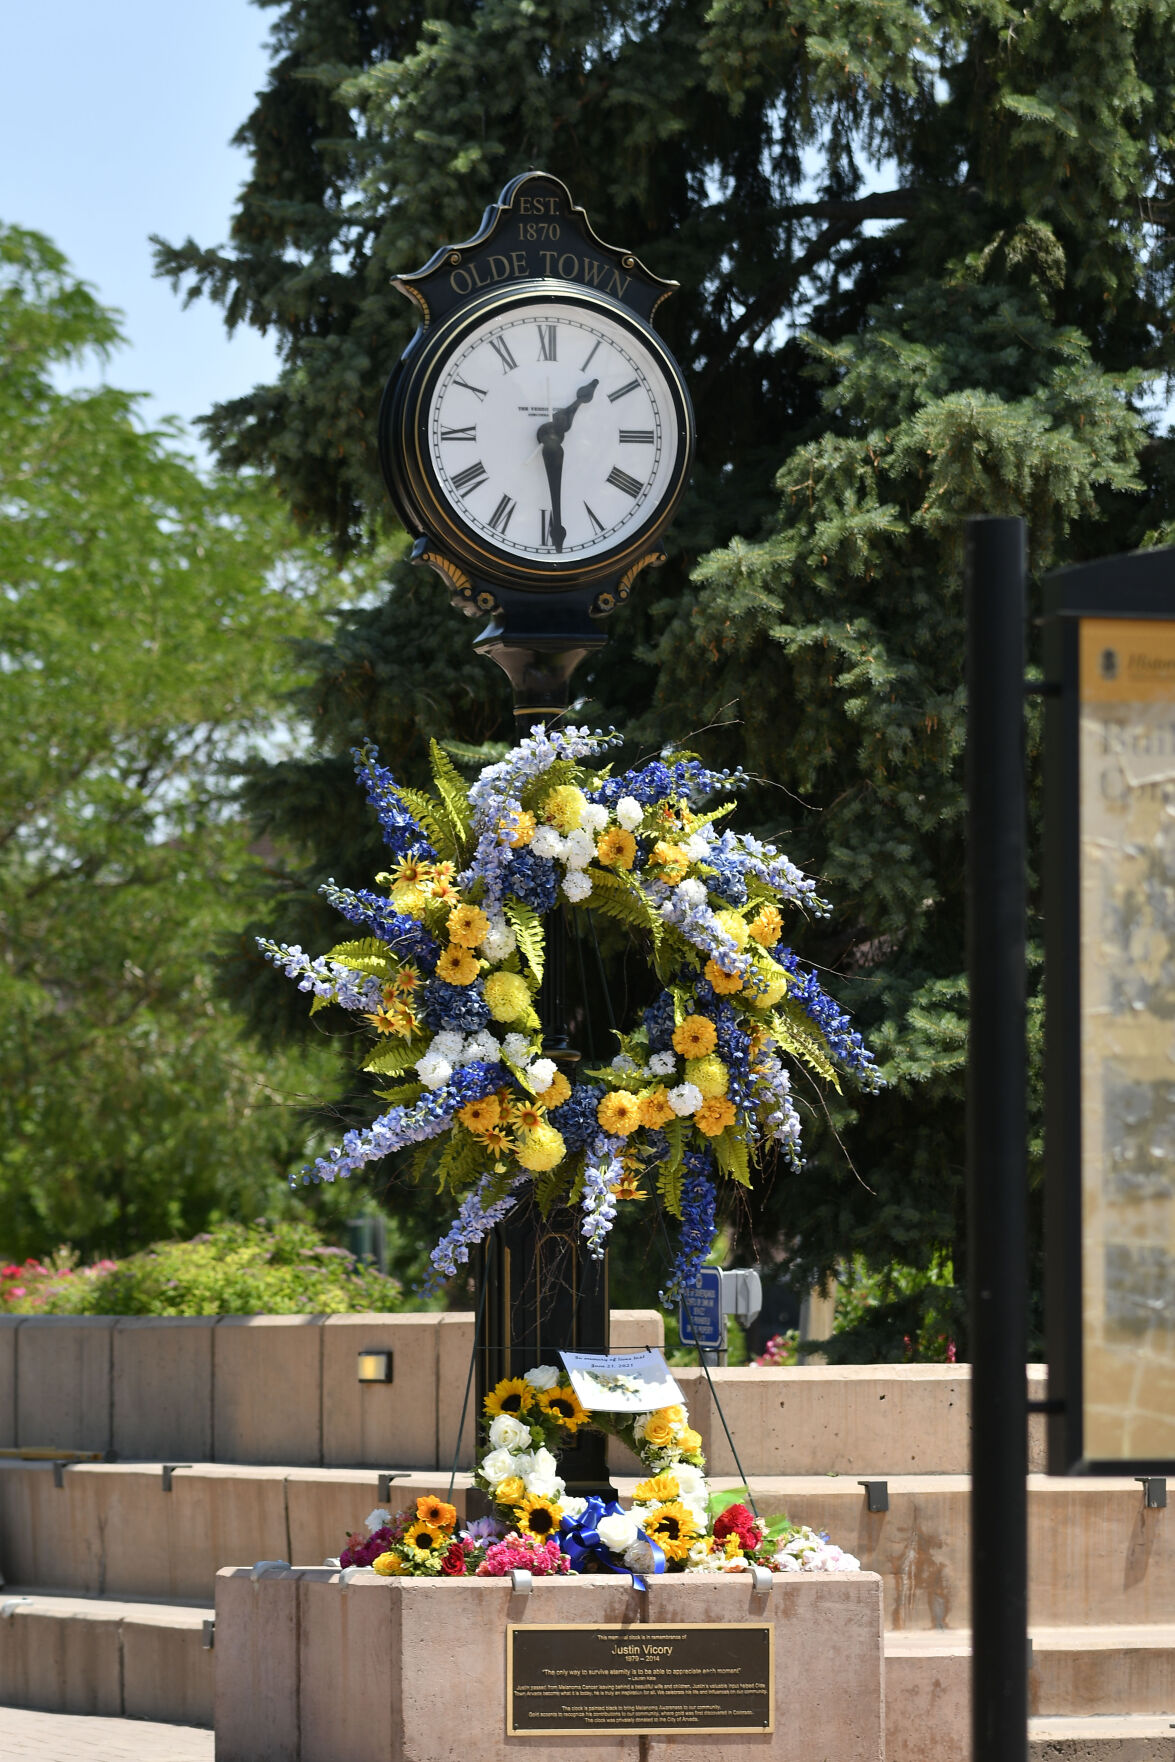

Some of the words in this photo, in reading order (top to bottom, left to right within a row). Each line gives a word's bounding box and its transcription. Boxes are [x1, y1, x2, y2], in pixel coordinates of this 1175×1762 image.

[519, 198, 560, 216] EST.
[518, 224, 561, 241] 1870
[449, 251, 531, 295] OLDE
[540, 251, 632, 299] TOWN
[537, 325, 558, 361] XII
[612, 1645, 640, 1655] Justin
[643, 1645, 673, 1657] Vicory
